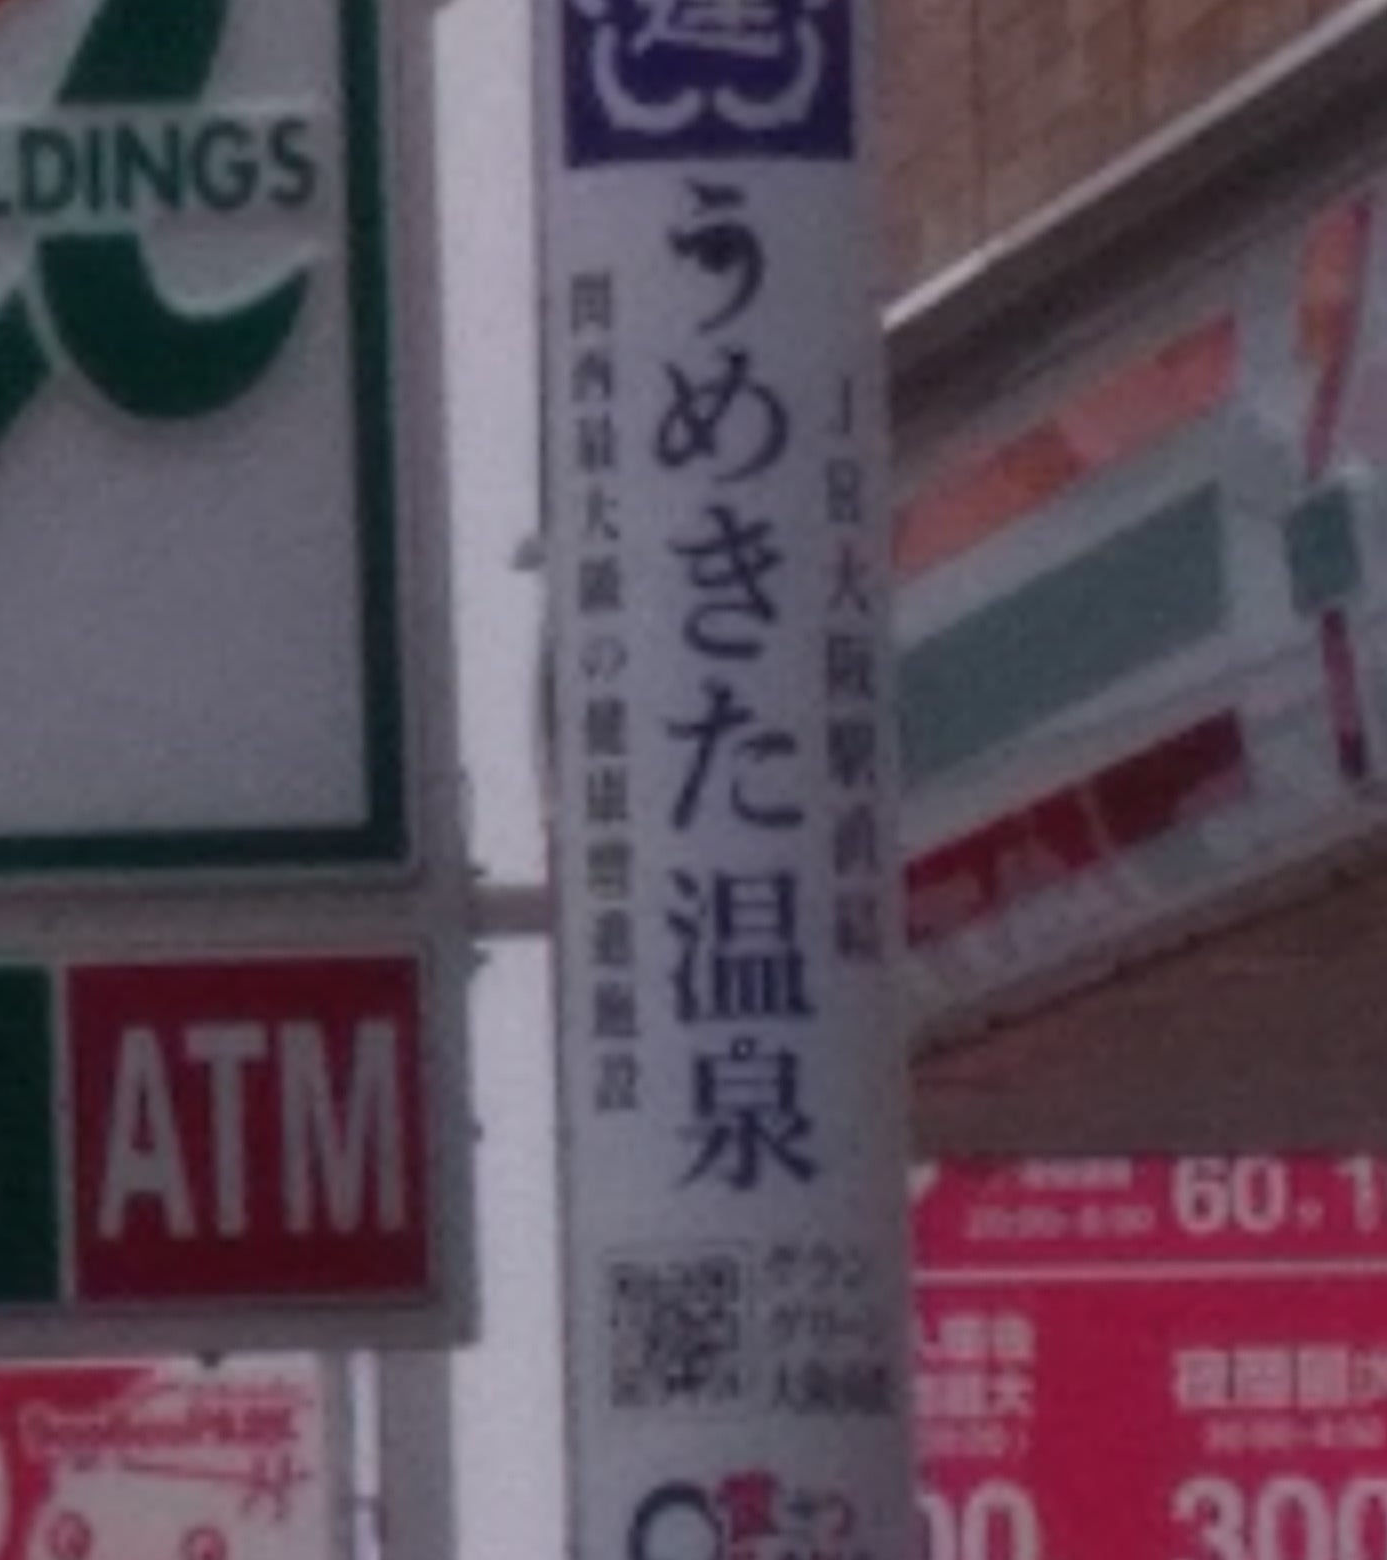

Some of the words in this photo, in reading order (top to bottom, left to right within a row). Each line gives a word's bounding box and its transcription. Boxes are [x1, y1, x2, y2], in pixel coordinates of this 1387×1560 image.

[653, 178, 822, 1190] うめきた温泉
[96, 1020, 407, 1240] ATM
